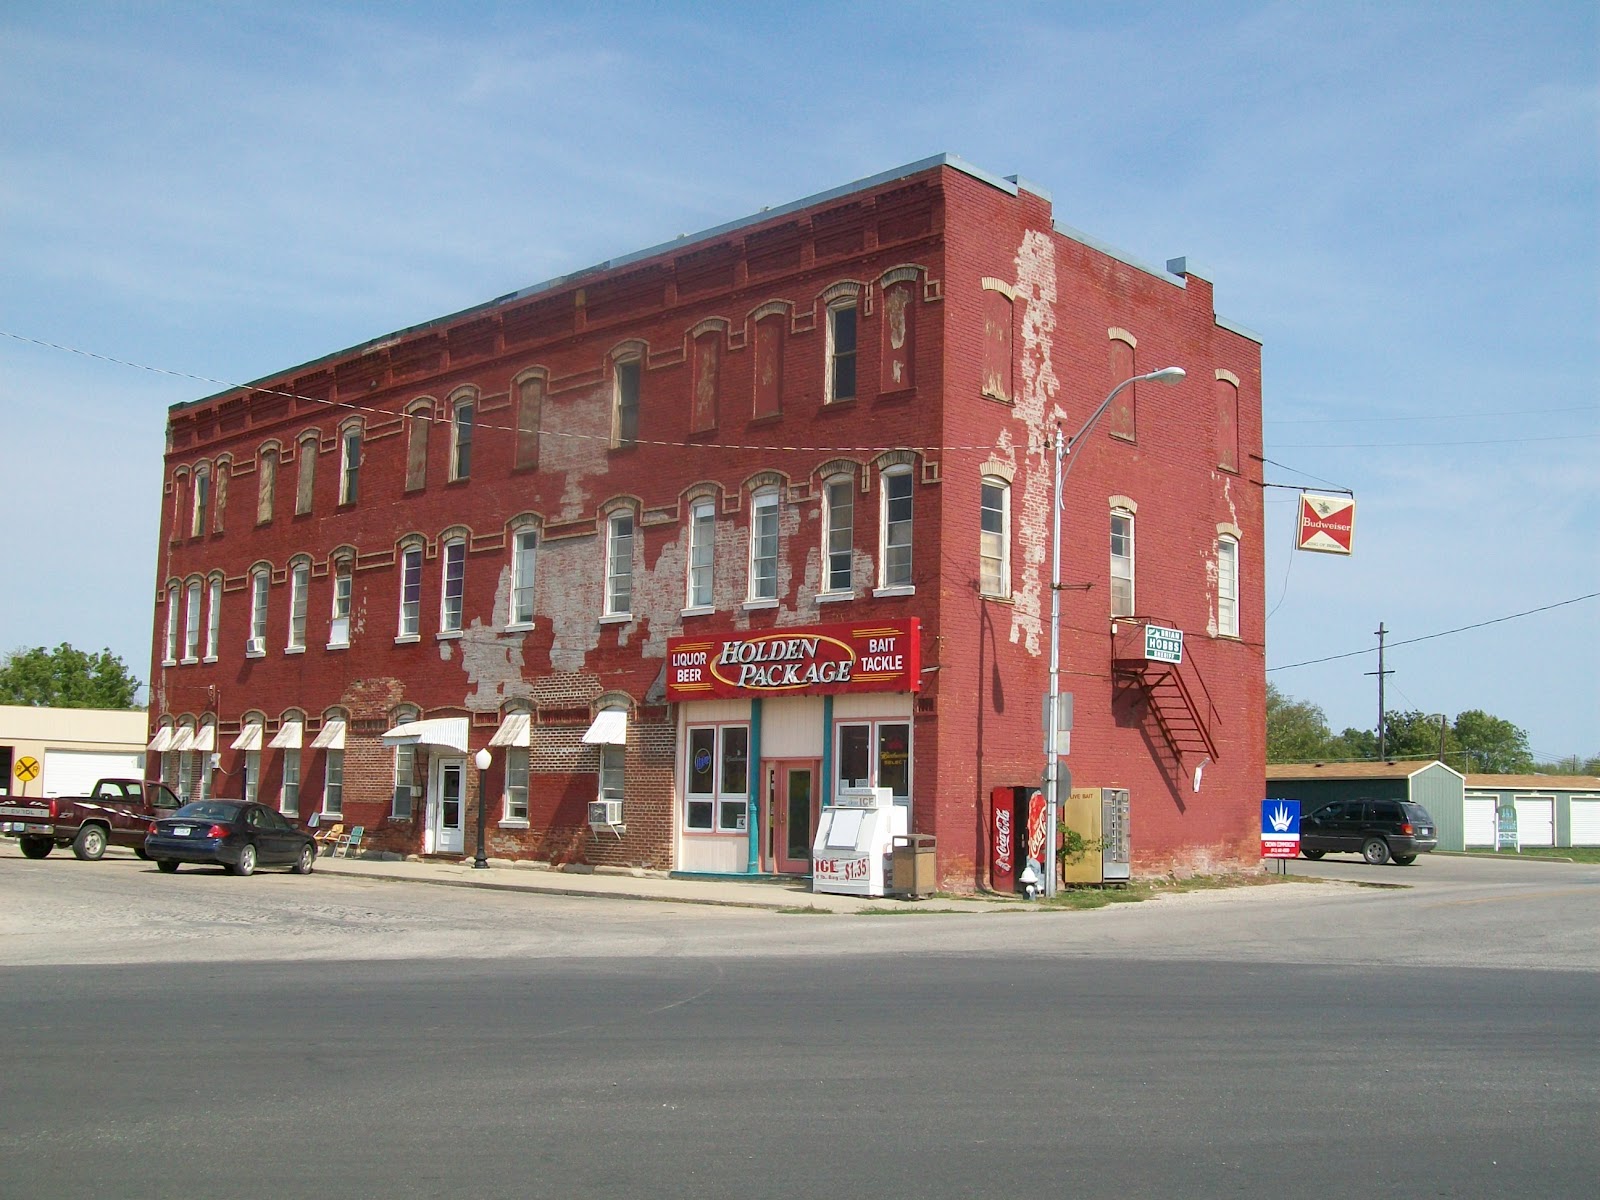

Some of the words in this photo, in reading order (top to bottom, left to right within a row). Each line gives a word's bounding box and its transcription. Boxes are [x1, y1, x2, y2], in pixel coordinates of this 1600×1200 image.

[1303, 517, 1351, 531] Budweiser
[719, 638, 821, 666] HOLDEN
[869, 638, 896, 653] BAIT
[1149, 638, 1180, 652] HOBBS
[673, 652, 707, 667] LIQUOR
[861, 655, 903, 672] TACKLE
[677, 669, 702, 683] BEER
[737, 661, 852, 687] PACKAGE
[859, 797, 874, 807] ICE
[996, 808, 1010, 858] Coca-Cola
[815, 859, 839, 873] ICE
[845, 858, 867, 881] $1.35
